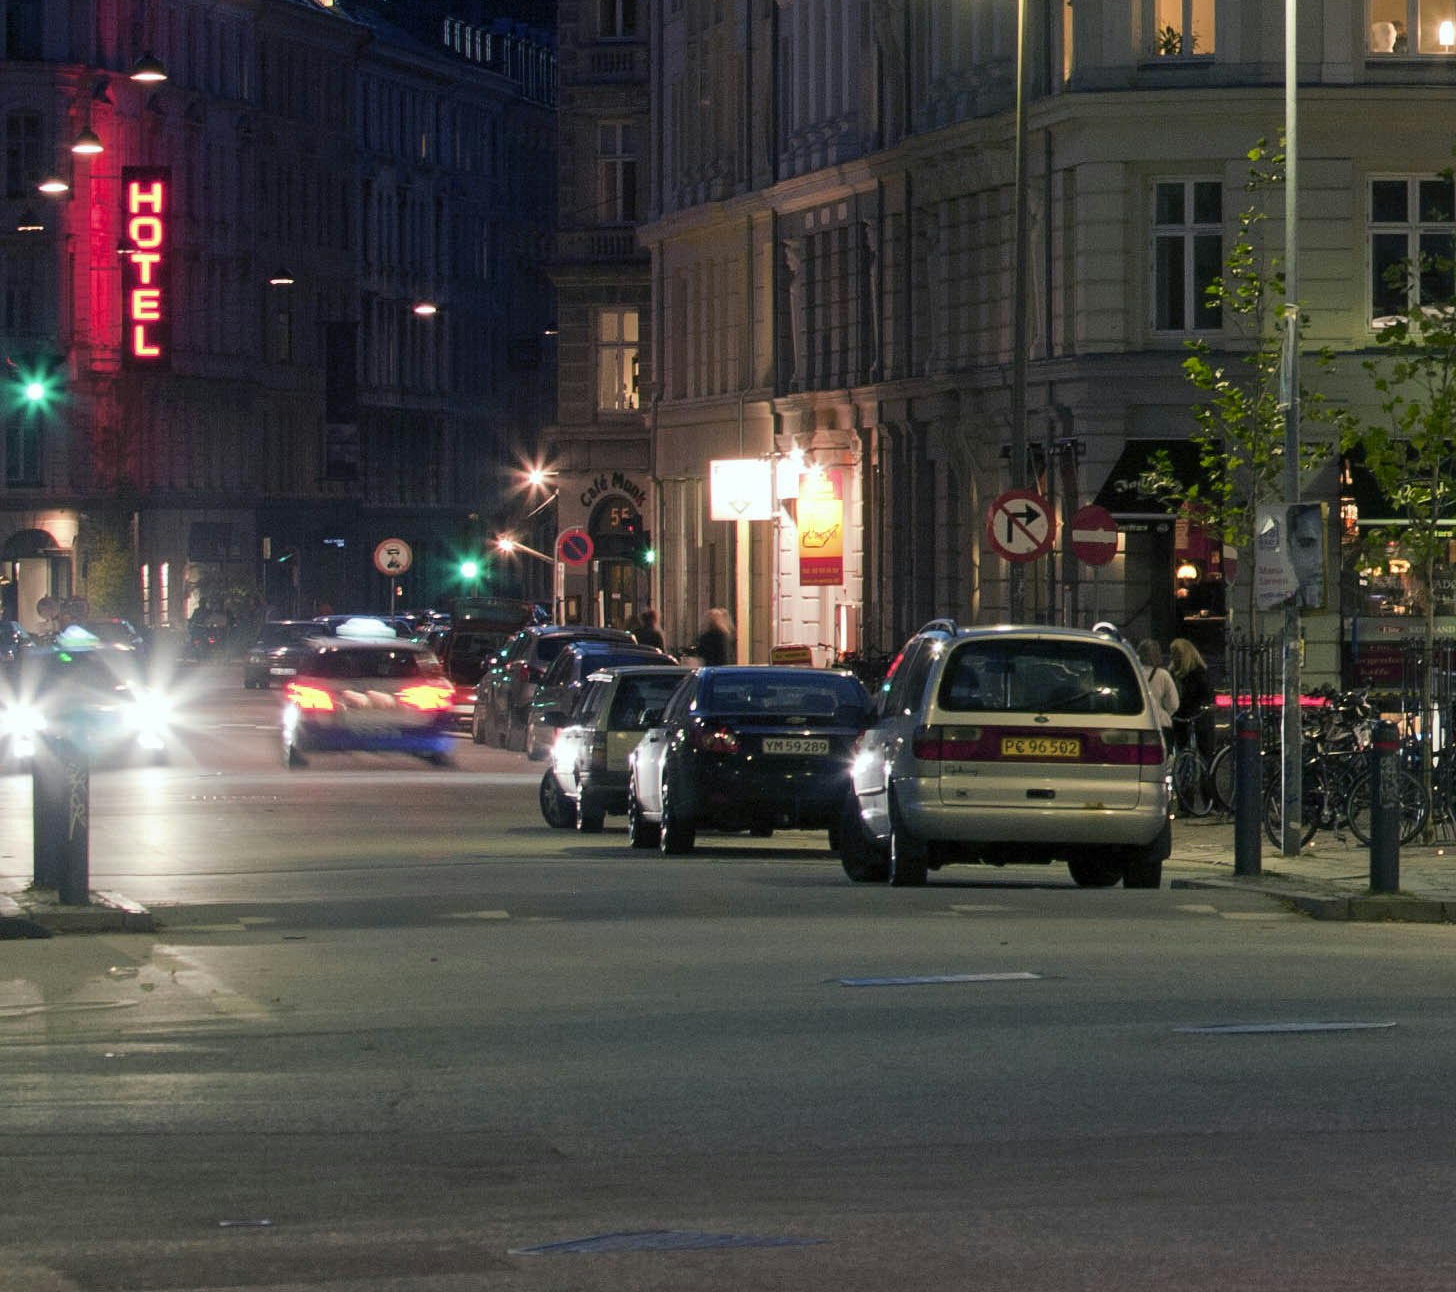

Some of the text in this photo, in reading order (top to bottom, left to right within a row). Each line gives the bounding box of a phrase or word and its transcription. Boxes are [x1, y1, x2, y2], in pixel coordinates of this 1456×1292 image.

[128, 181, 163, 357] HOTEL
[580, 474, 608, 507] Café
[766, 740, 827, 752] YM 59 289
[1005, 739, 1077, 755] PC 96 502
